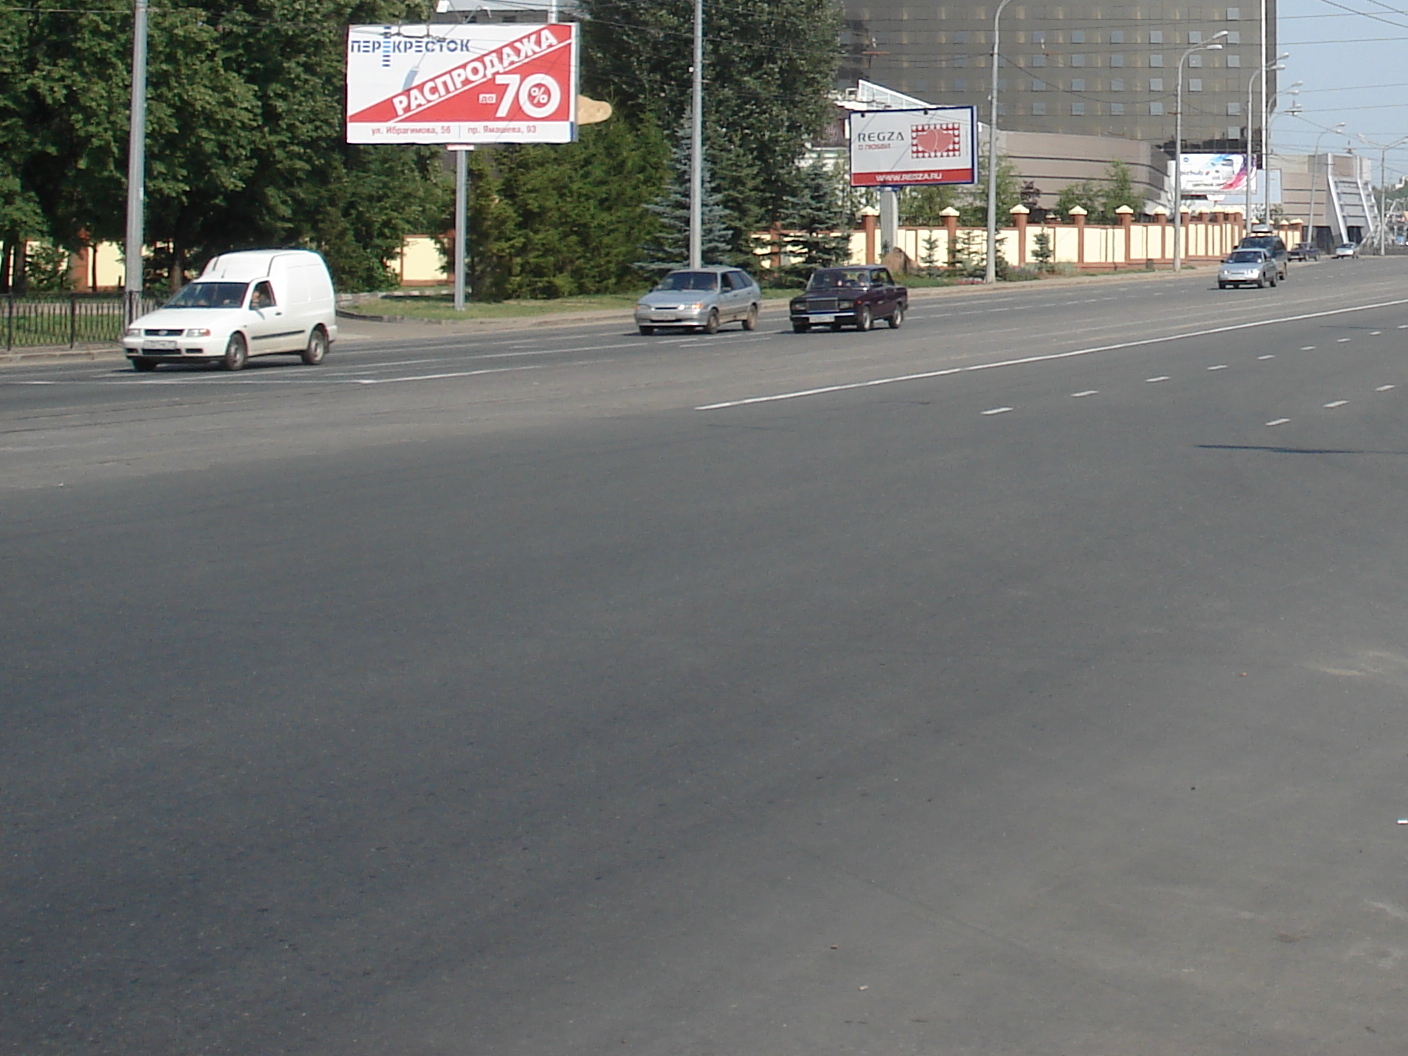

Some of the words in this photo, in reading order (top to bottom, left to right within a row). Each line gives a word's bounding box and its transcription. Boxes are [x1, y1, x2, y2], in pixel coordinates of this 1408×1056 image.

[350, 39, 471, 53] ПЕРЕКРЕСТОК
[392, 29, 558, 116] РАСПРОДАЖА
[858, 131, 905, 142] REGZA
